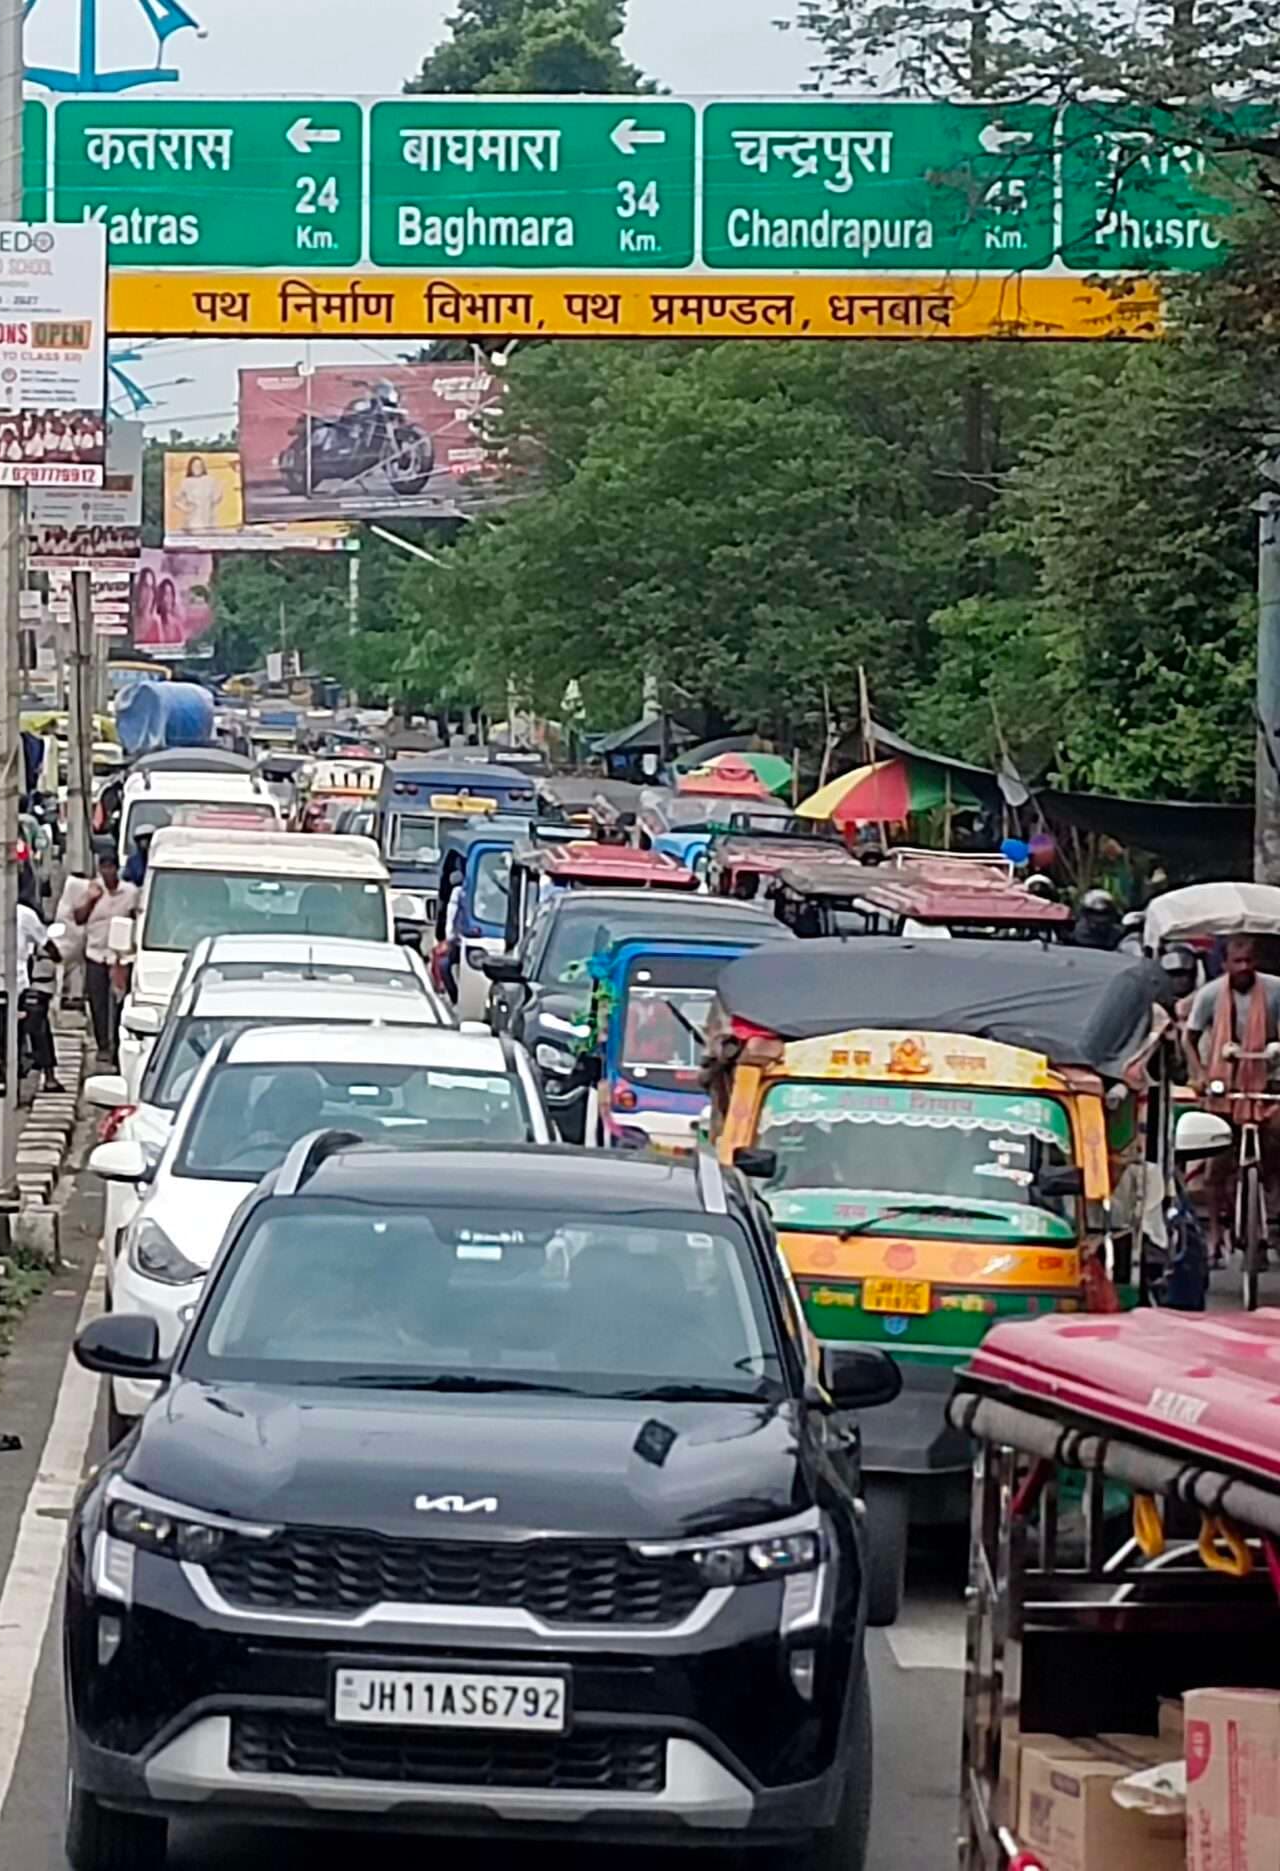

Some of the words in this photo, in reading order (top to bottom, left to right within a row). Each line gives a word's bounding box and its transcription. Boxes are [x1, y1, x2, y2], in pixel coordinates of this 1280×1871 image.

[84, 128, 233, 171] कतरास
[399, 129, 561, 172] बाघमारा
[731, 130, 894, 193] चन्द्रपुरा
[295, 177, 339, 214] 24
[616, 181, 660, 219] 34
[296, 225, 338, 249] Km.
[399, 206, 573, 256] Baghmara
[619, 229, 661, 252] Km.
[728, 209, 933, 258] Chandrapura
[985, 226, 1028, 249] Km.
[194, 292, 249, 323] पथ
[279, 281, 394, 323] निर्माण
[425, 281, 546, 331] विभाग,
[567, 294, 621, 323] पथ
[651, 294, 811, 332] प्रमण्डल,
[828, 294, 955, 327] धनबाद
[34, 323, 85, 346] OPEN
[358, 1680, 561, 1719] JH11AS6792
